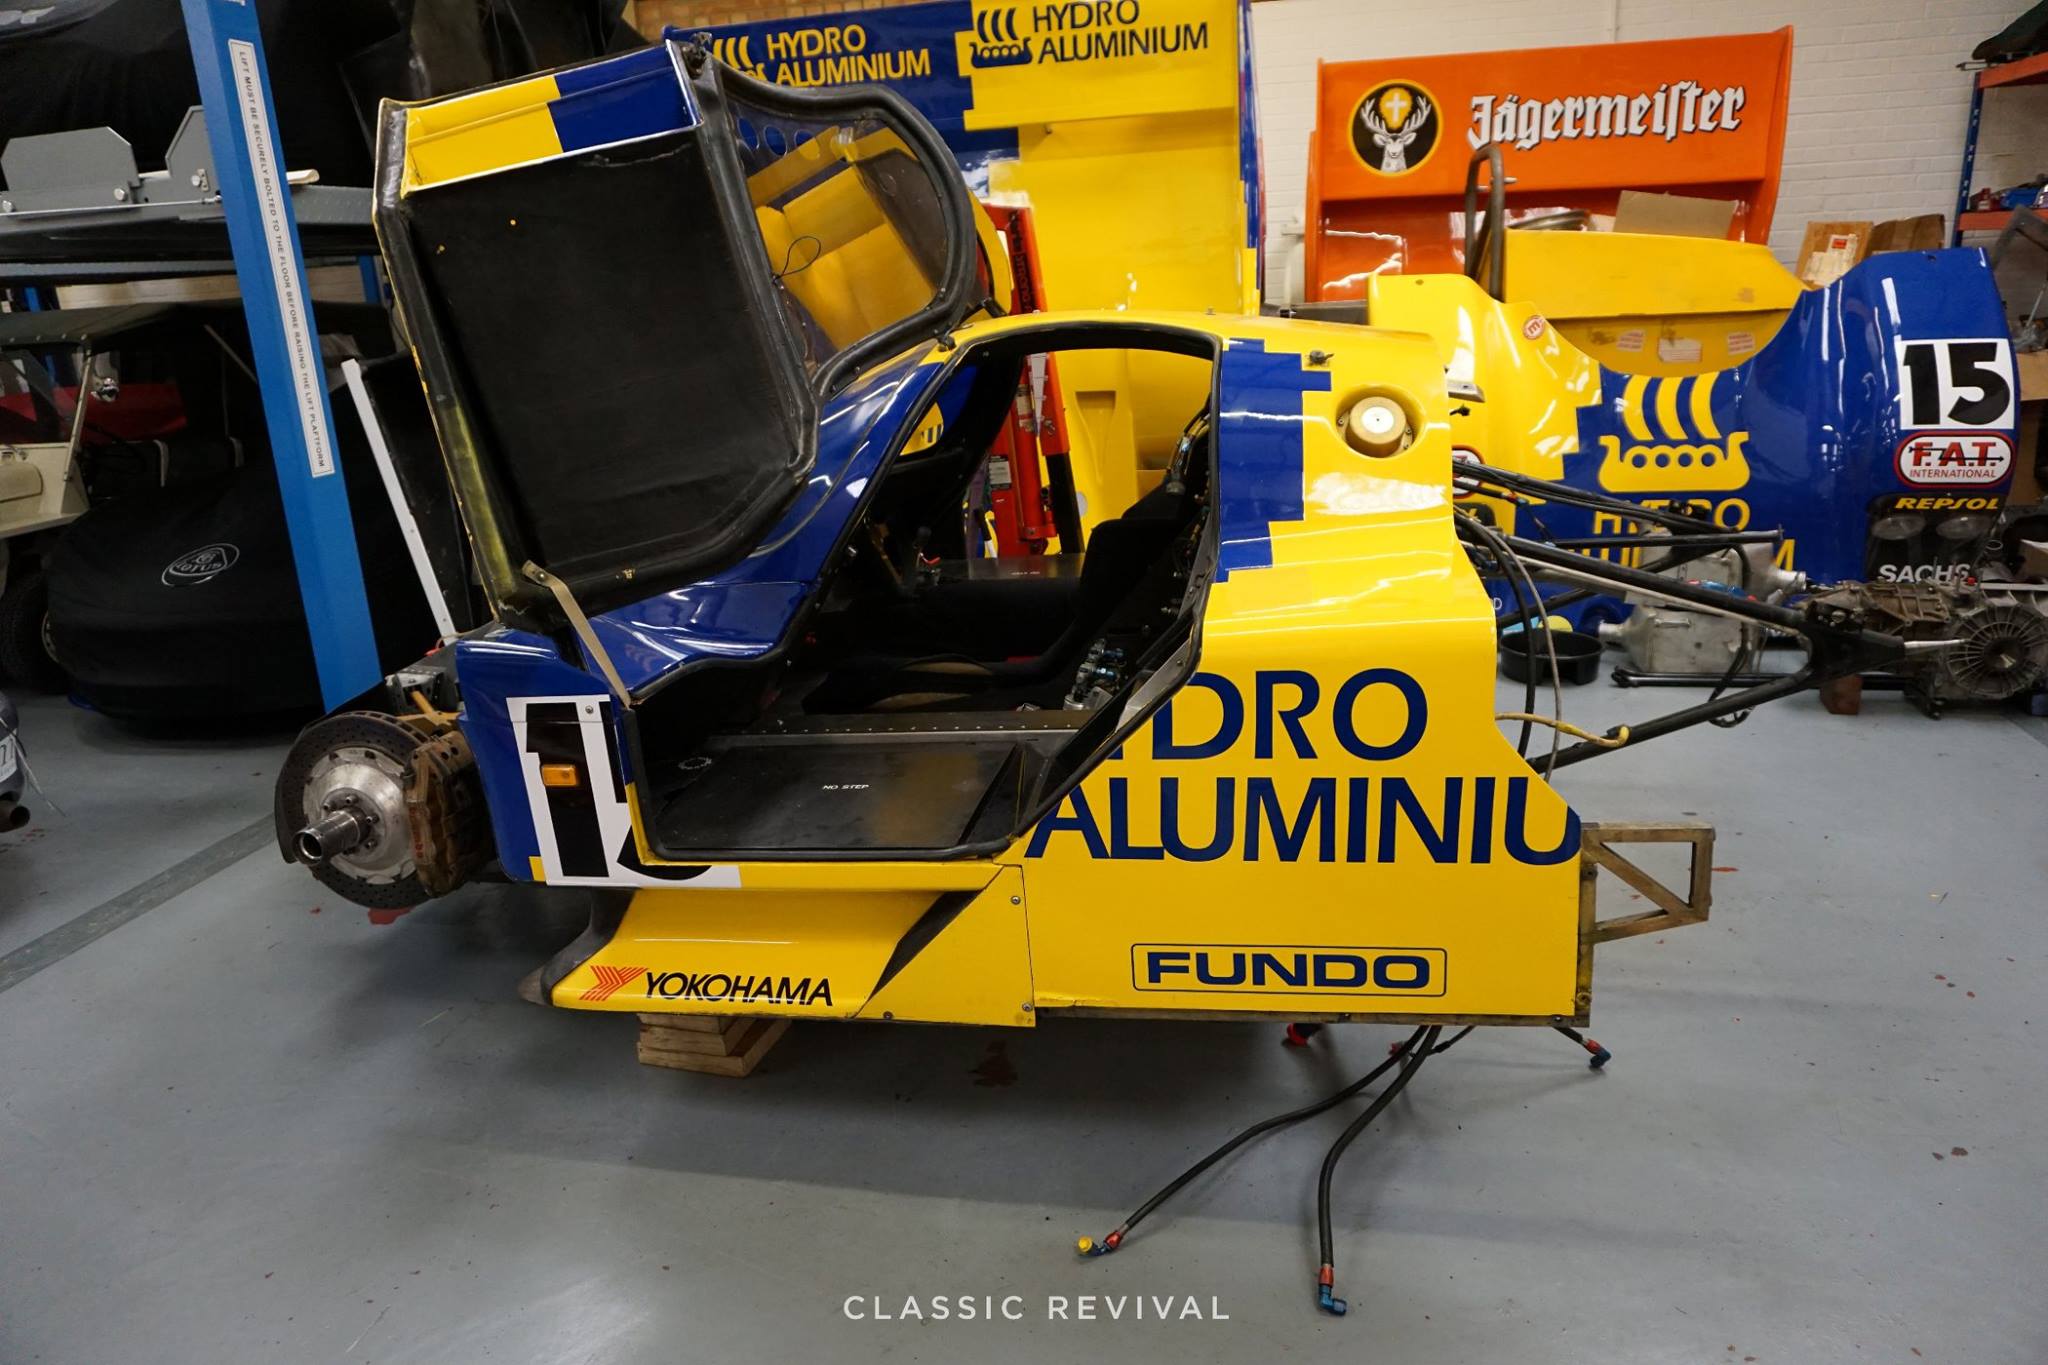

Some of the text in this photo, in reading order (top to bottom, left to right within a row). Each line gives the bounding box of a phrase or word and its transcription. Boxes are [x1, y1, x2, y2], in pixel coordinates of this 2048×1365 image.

[1033, 0, 1140, 33] HYDRO
[766, 24, 867, 60] HYDRO
[1038, 22, 1208, 64] ALUMINIUM
[239, 51, 249, 73] LIFT
[776, 48, 931, 87] ALUMINIUM
[245, 76, 255, 104] MUST
[250, 107, 258, 119] BE
[253, 123, 268, 175] SECURELY
[264, 177, 276, 216] BOLTED
[273, 219, 279, 232] TO
[276, 235, 284, 253] THE
[279, 256, 291, 288] FLOOR
[286, 291, 299, 328] BEFORE
[295, 331, 306, 369] RAISING
[302, 372, 310, 389] THE
[1903, 342, 2011, 426] 15
[305, 391, 314, 410] LIFT
[1909, 468, 1997, 479] INTERNATIONAL
[1895, 497, 2000, 510] REPSOL
[1878, 563, 1972, 584] SACHS
[1100, 668, 1429, 761] DRO
[1146, 951, 1430, 989] FUNDO
[646, 972, 834, 1007] YOKOHAMA
